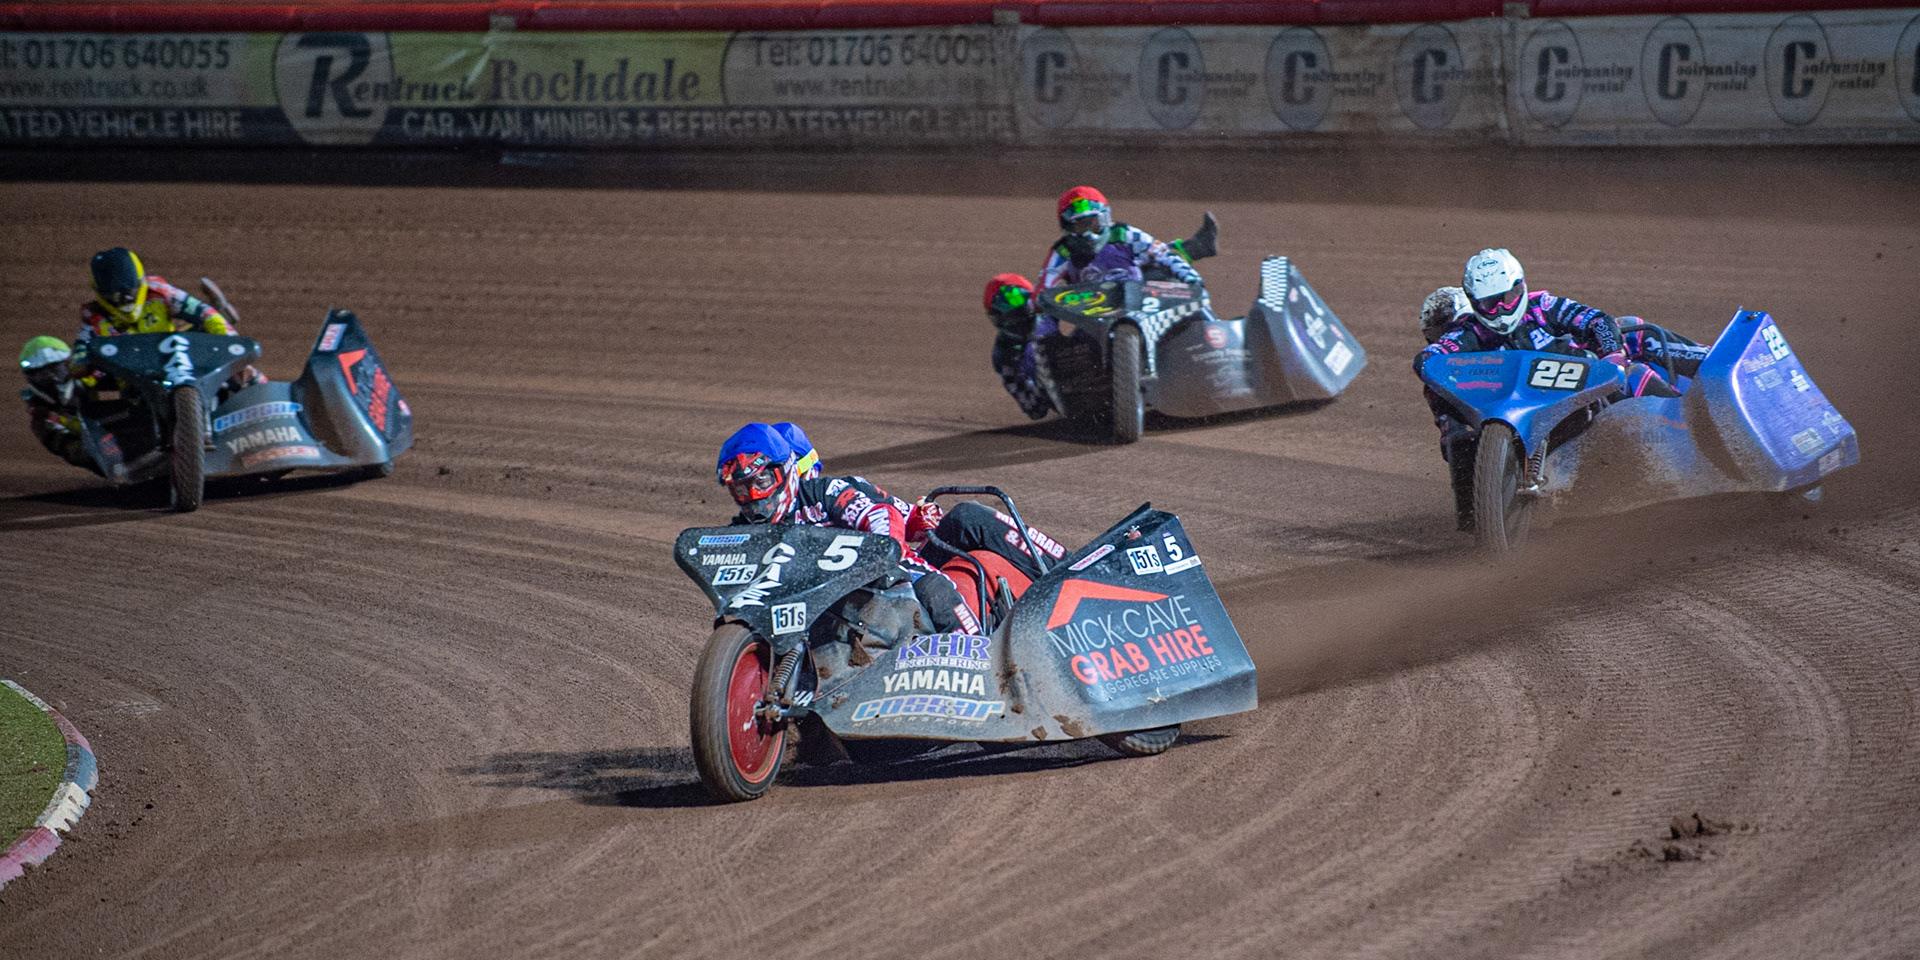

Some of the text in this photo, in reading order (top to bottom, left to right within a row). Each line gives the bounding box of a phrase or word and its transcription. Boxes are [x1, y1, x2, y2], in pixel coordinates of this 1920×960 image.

[25, 39, 116, 69] 01706
[123, 39, 230, 69] 640055
[807, 36, 893, 66] 01706
[488, 58, 702, 101] Rochdale
[66, 111, 179, 139] VEHICLE
[184, 111, 243, 139] HIRE
[532, 111, 632, 139] MINIBUS
[1142, 297, 1160, 312] 2
[1530, 360, 1585, 389] 22
[226, 426, 303, 454] YAMAHA
[817, 534, 865, 572] 5
[1027, 526, 1066, 560] GRAB
[1162, 535, 1183, 562] 5
[702, 553, 747, 566] YAMAHA
[1046, 595, 1198, 658] MICK CAVE
[895, 633, 992, 663] KHR
[1070, 624, 1215, 686] GRAB HIRE
[894, 657, 992, 672] ENGINEERING
[1098, 665, 1171, 700] AGGREGATE
[1170, 654, 1223, 678] SUPPLIES
[882, 669, 986, 696] YAMAHA
[851, 715, 985, 729] MOTORSPORT
